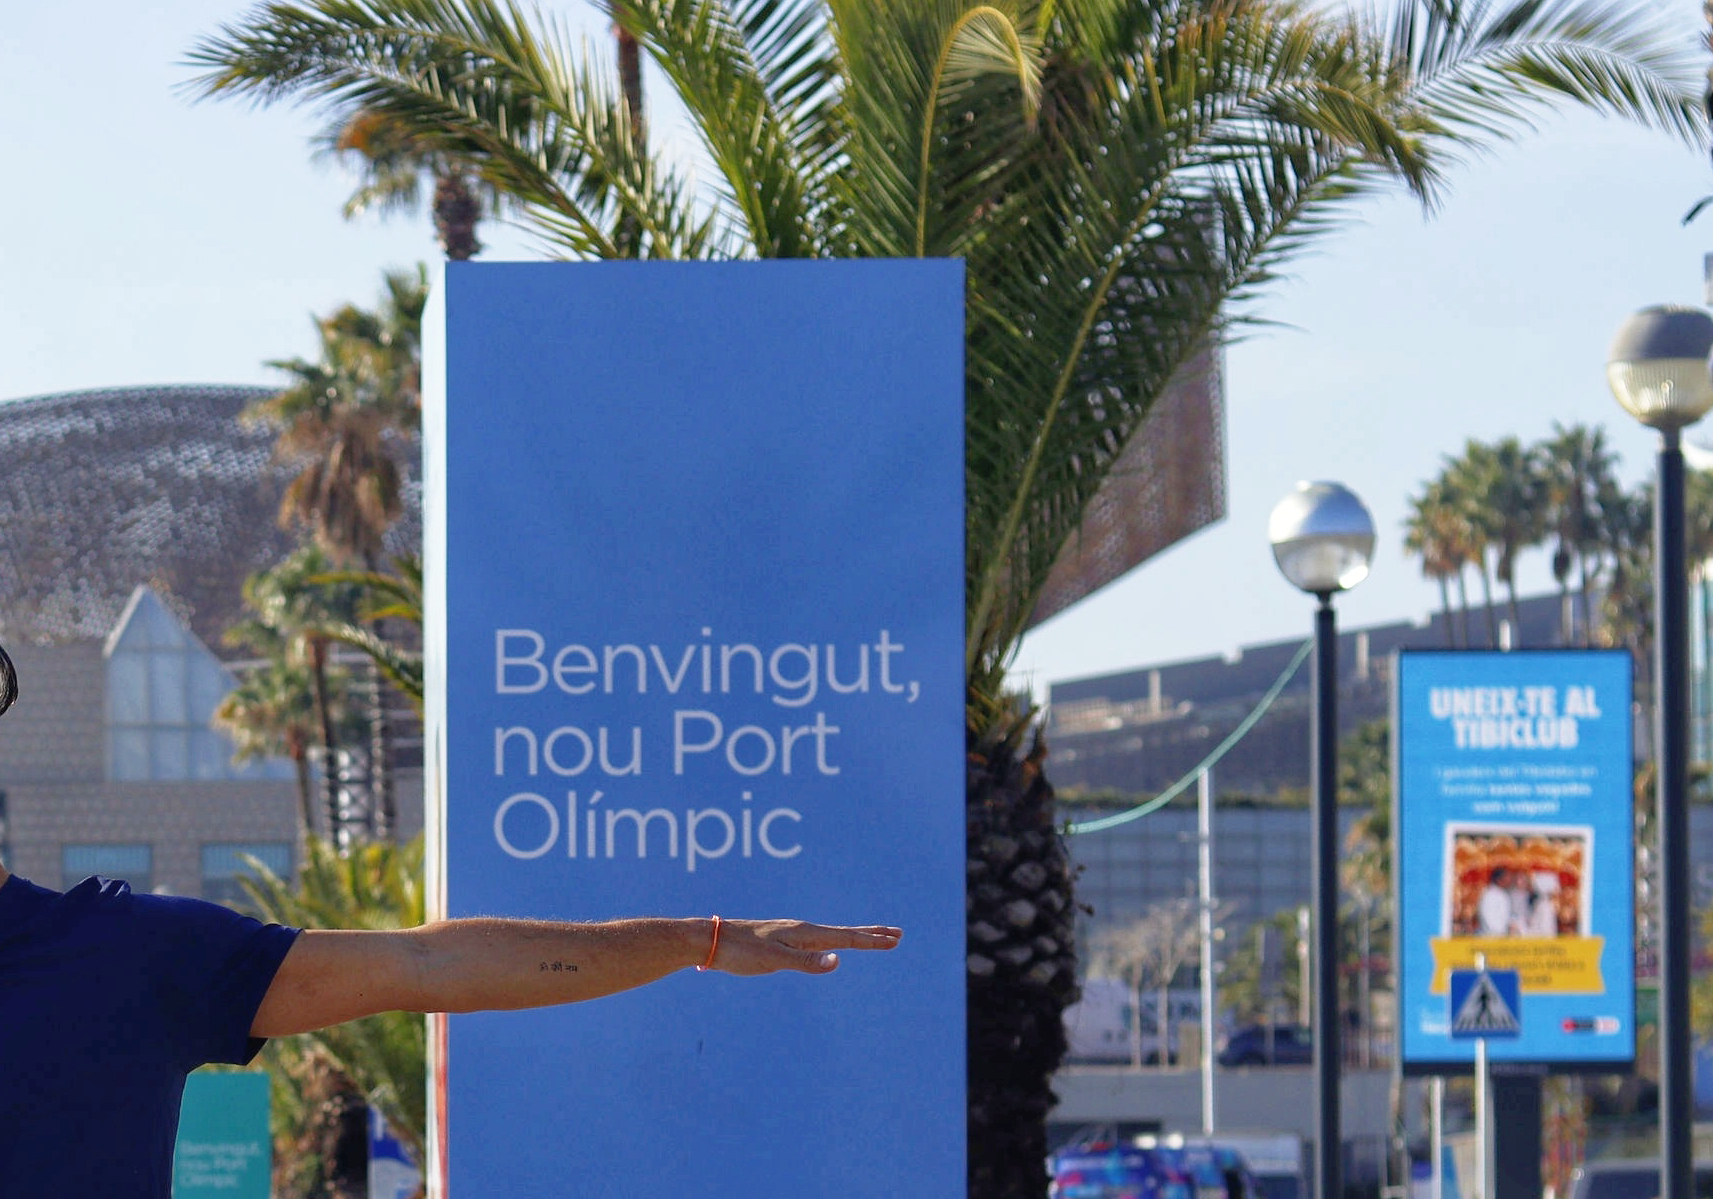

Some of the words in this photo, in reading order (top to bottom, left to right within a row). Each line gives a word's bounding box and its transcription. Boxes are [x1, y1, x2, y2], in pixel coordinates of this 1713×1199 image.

[494, 625, 922, 708] Benvingut,
[1453, 716, 1579, 749] TIBICLUB
[1564, 684, 1602, 718] AL
[494, 725, 642, 777] nou
[673, 709, 841, 777] Port
[492, 789, 804, 873] Olímpic
